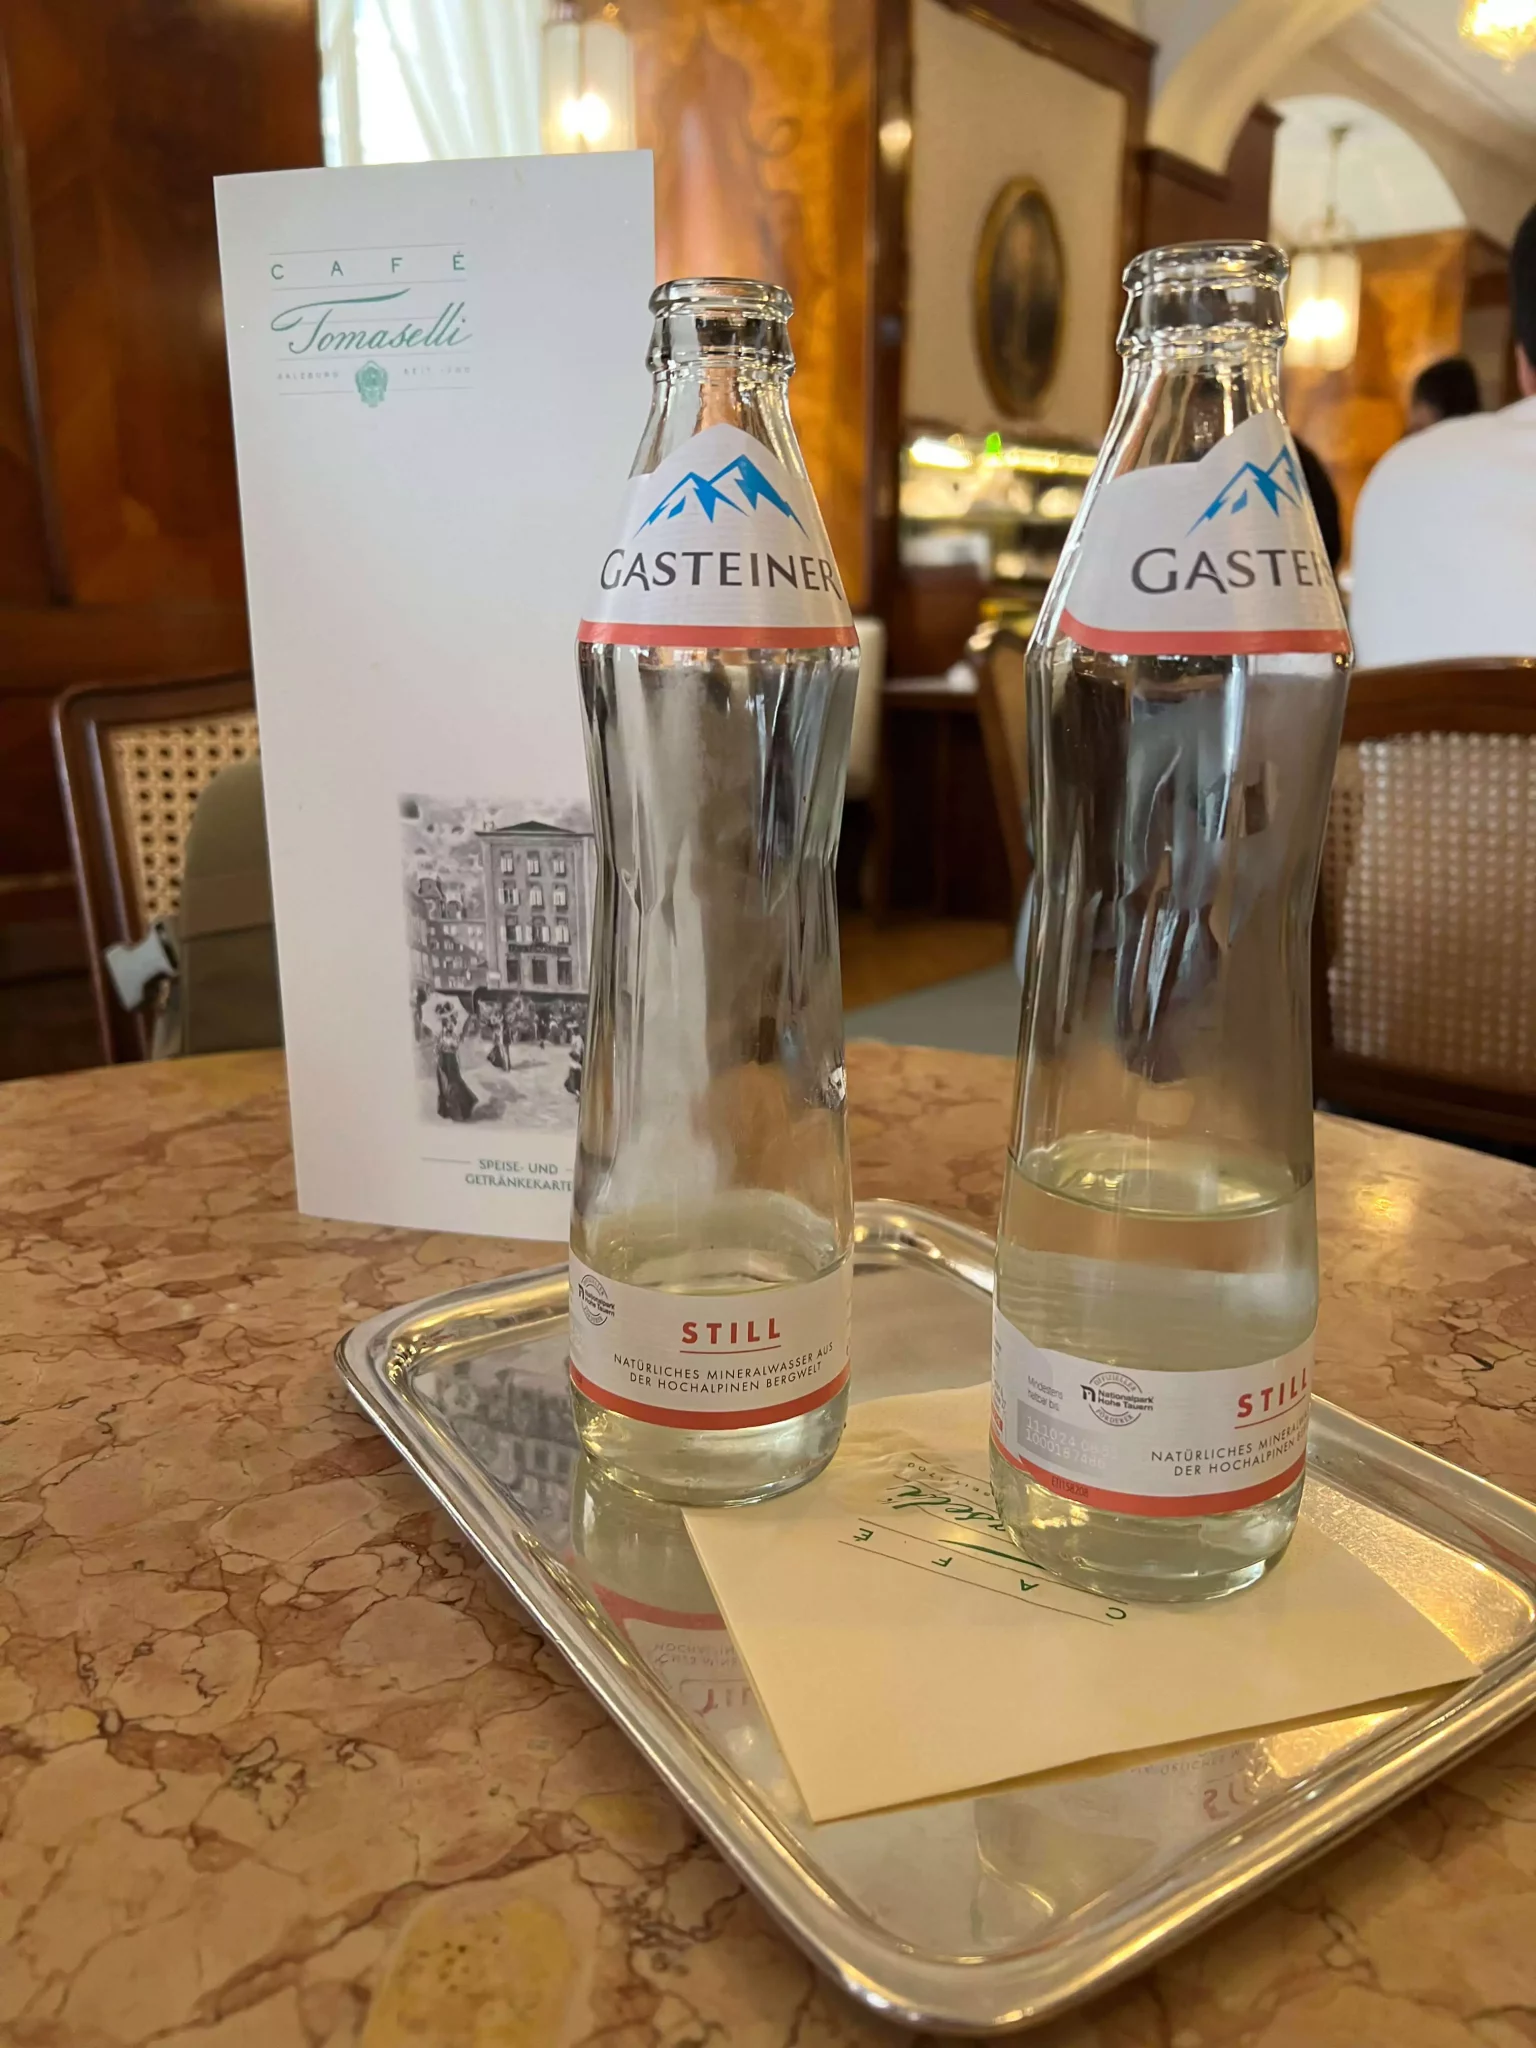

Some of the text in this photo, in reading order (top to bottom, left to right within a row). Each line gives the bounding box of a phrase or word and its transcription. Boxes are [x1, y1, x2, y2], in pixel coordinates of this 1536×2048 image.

[271, 251, 465, 280] CAFÉ
[271, 288, 473, 354] Tomaselli
[600, 548, 843, 600] GASTEINER
[528, 1163, 558, 1175] UND
[681, 1318, 781, 1344] STILL
[614, 1341, 834, 1380] NATÜRLICHES MINERALWASSER AUS
[629, 1361, 822, 1394] DER HOCHALPINEN BERGWELT
[1237, 1368, 1307, 1418] STILL
[1098, 1398, 1121, 1407] Hohe
[1151, 1443, 1252, 1462] NATÜRLICHES
[1174, 1439, 1294, 1476] DER HOCHALPINEN
